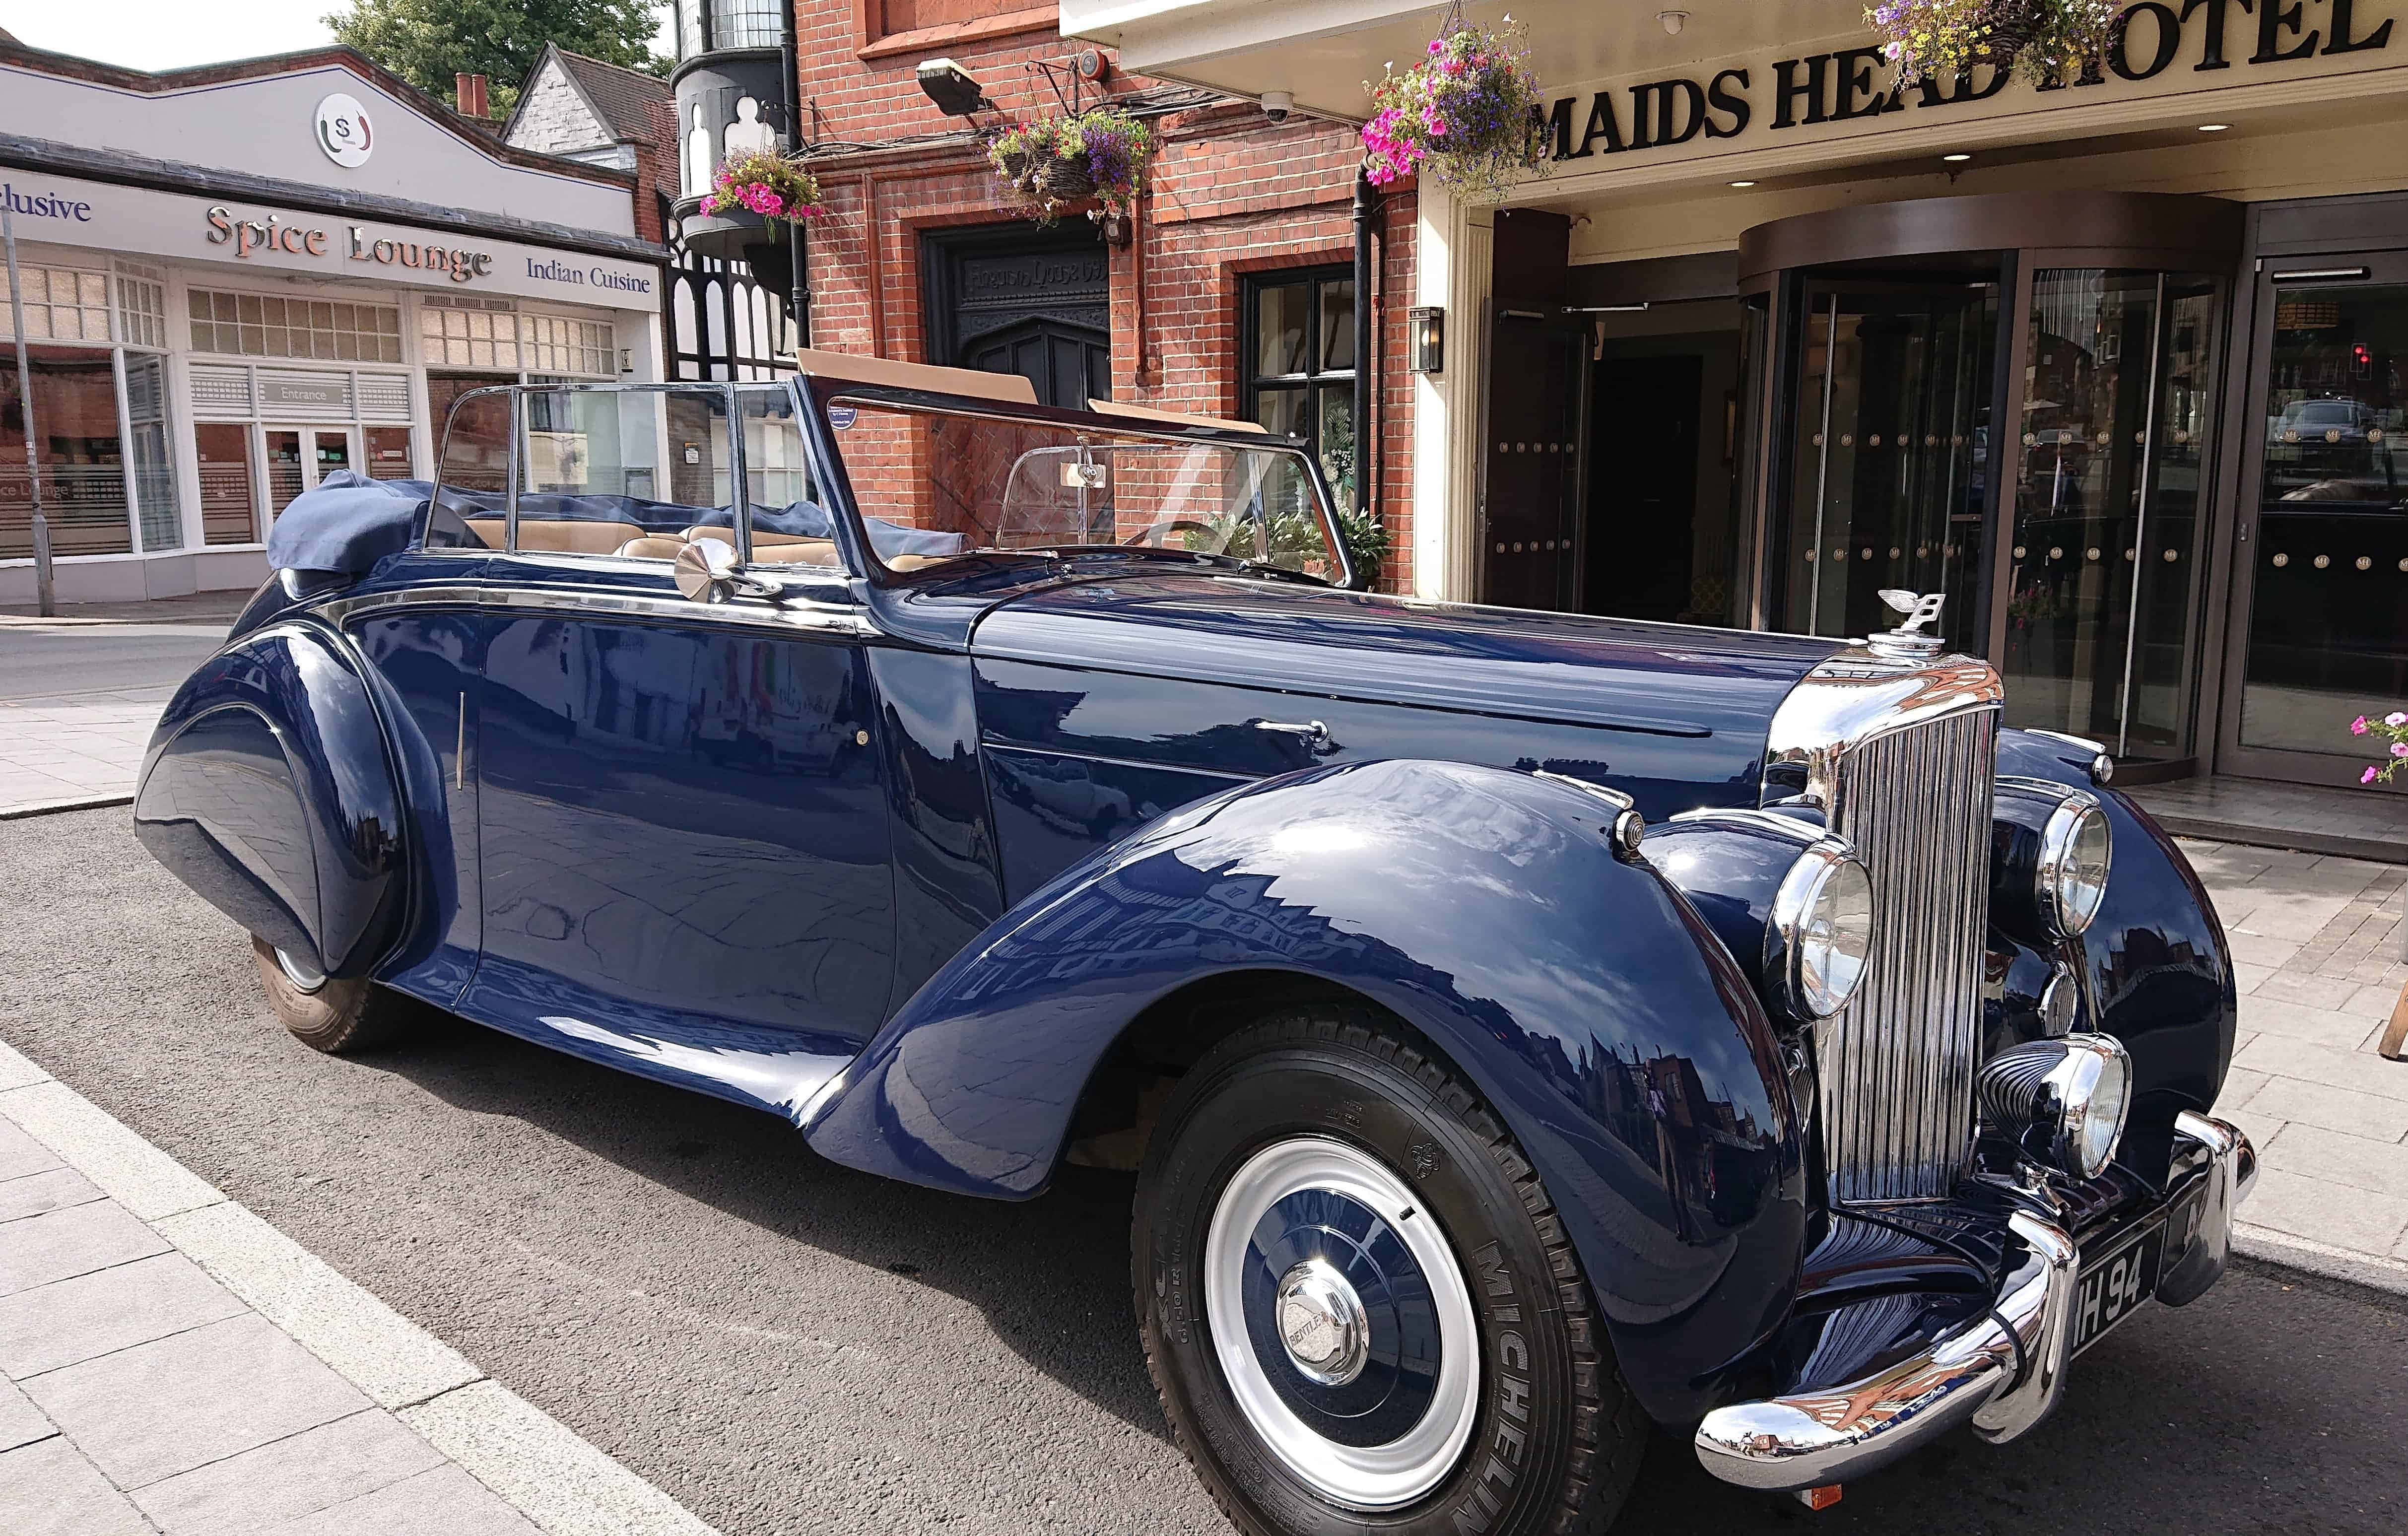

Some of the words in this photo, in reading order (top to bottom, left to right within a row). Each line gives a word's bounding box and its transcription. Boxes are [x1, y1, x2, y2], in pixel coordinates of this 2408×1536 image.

[1522, 68, 1750, 163] MAIDS
[2036, 0, 2394, 92] OTEL
[0, 183, 91, 222] lusive
[207, 206, 329, 258] Spice
[348, 225, 493, 282] Lounge
[526, 258, 584, 284] Indian
[590, 267, 651, 293] Cuisine
[281, 387, 327, 400] Entrance
[20, 482, 68, 500] Lunge
[1450, 1240, 1532, 1536] MICHELIN
